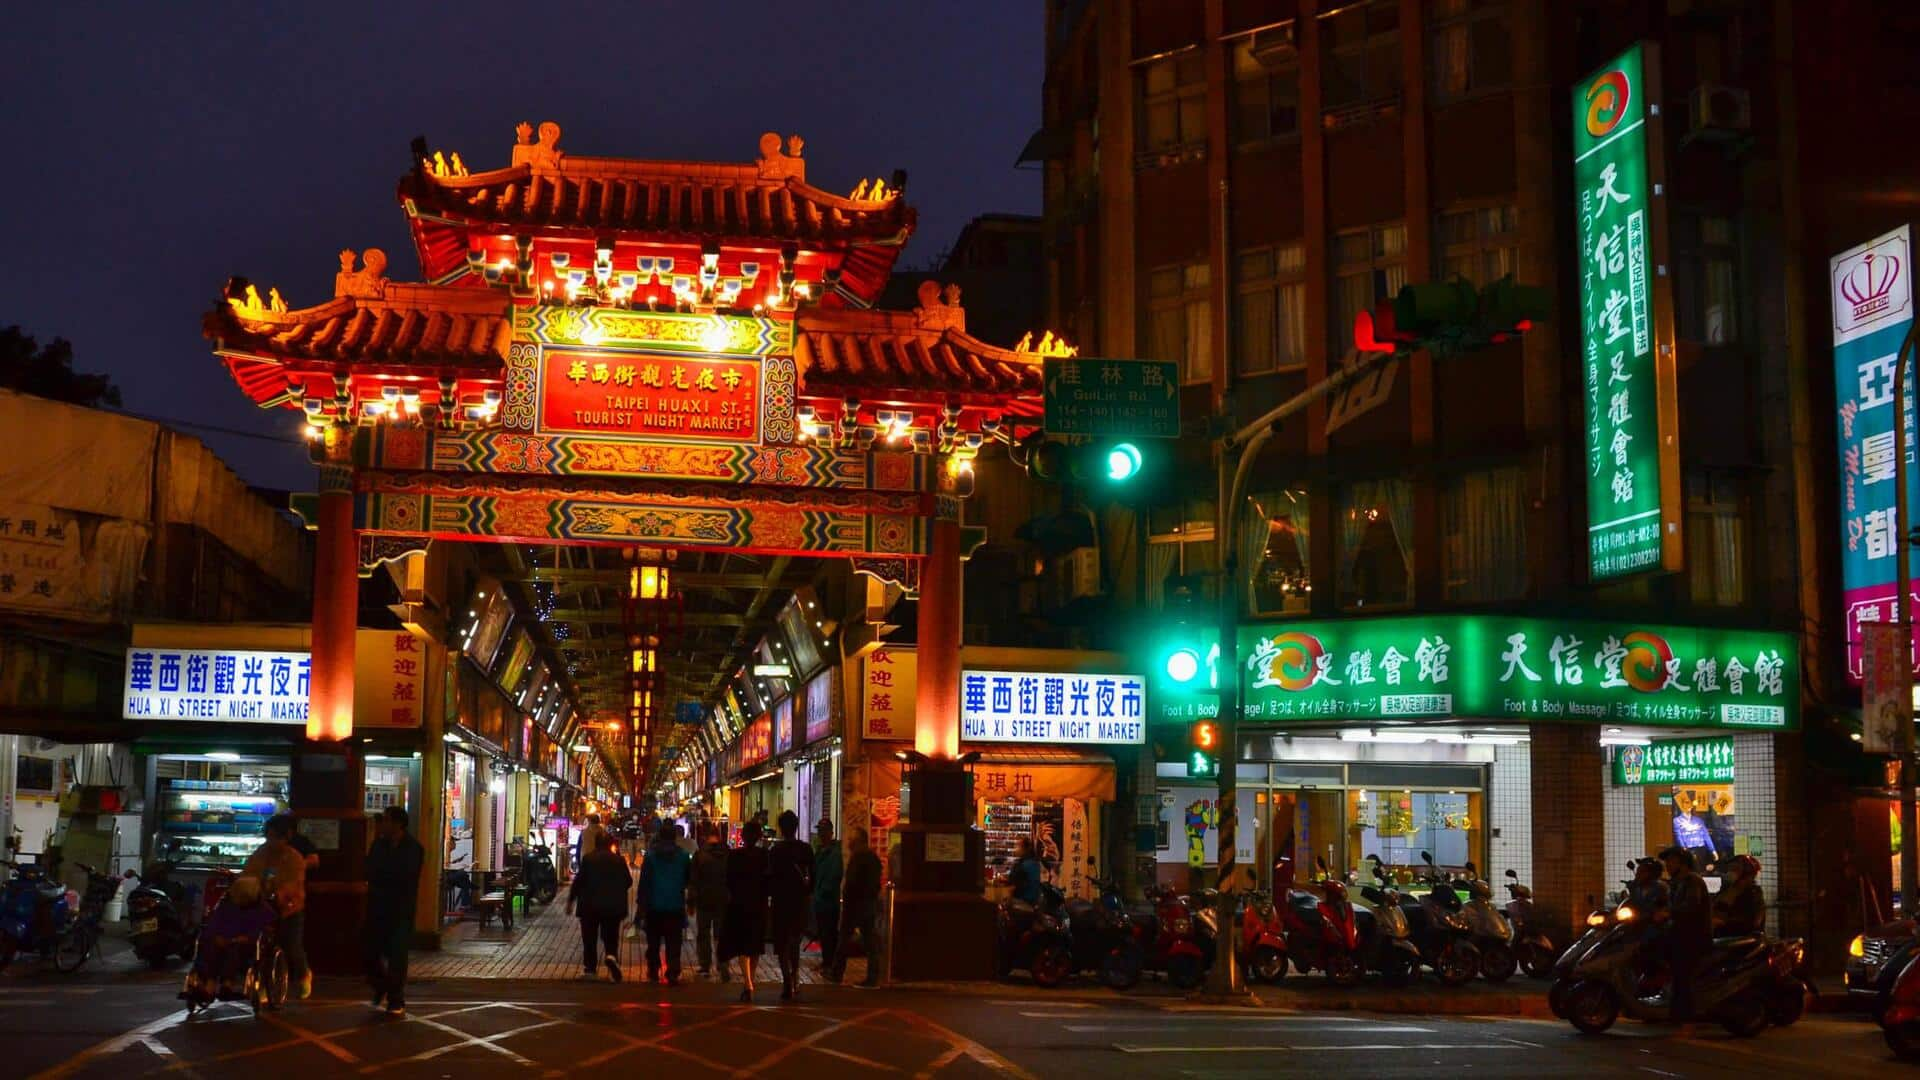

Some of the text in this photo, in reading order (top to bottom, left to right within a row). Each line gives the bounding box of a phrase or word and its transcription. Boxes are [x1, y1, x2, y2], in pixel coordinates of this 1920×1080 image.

[1595, 162, 1633, 504] 天信堂足體會館
[566, 360, 743, 393] 華西街觀光夜市
[1057, 363, 1164, 386] 桂林路
[606, 395, 742, 415] TAIPEI HUAXI ST.
[575, 411, 743, 431] TOURIST NIGHT MARKET
[965, 674, 1142, 719] 華西街觀光夜市
[1504, 699, 1526, 714] Foot
[1531, 701, 1538, 714] &
[1542, 700, 1565, 717] Body
[128, 696, 309, 721] HUA XI STREET NIGHT MARKE
[1162, 703, 1183, 717] Foot
[1187, 705, 1194, 716] &
[1197, 703, 1219, 718] Body
[965, 718, 1142, 741] HUA XI STREET NIGHT MARKET
